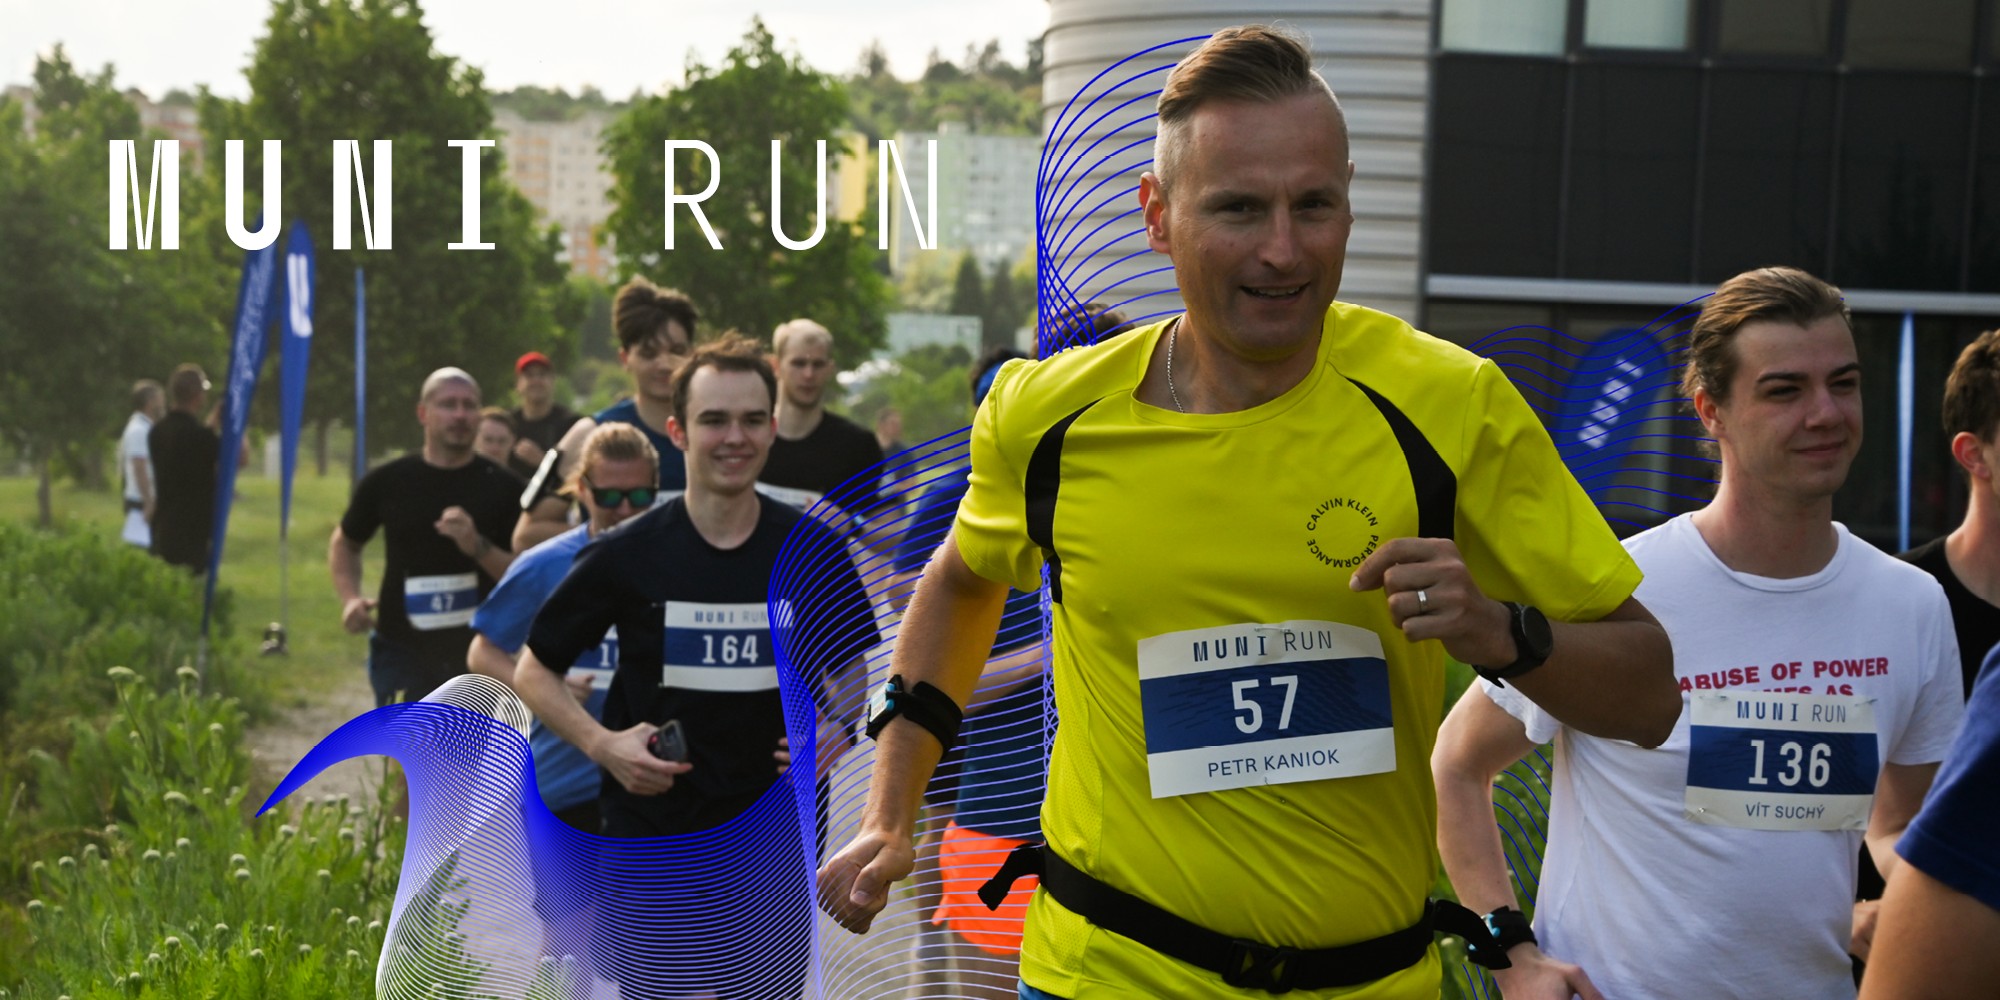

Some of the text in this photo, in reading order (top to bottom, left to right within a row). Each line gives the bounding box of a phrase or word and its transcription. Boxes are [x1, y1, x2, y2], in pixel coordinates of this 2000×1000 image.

[1307, 498, 1343, 531] CALVIN
[1347, 499, 1378, 526] KLEIN
[702, 635, 759, 664] 164
[1193, 631, 1332, 662] MUNI RUN
[1680, 666, 1760, 692] ABUSE
[1771, 662, 1802, 681] OF
[1813, 657, 1889, 678] POWER
[1231, 675, 1299, 734] 57
[1737, 701, 1846, 723] MUNI RUN
[1208, 749, 1340, 777] PETR KANIOK
[1748, 740, 1832, 787] 136
[1746, 802, 1825, 819] VÍT SUCHÝ
